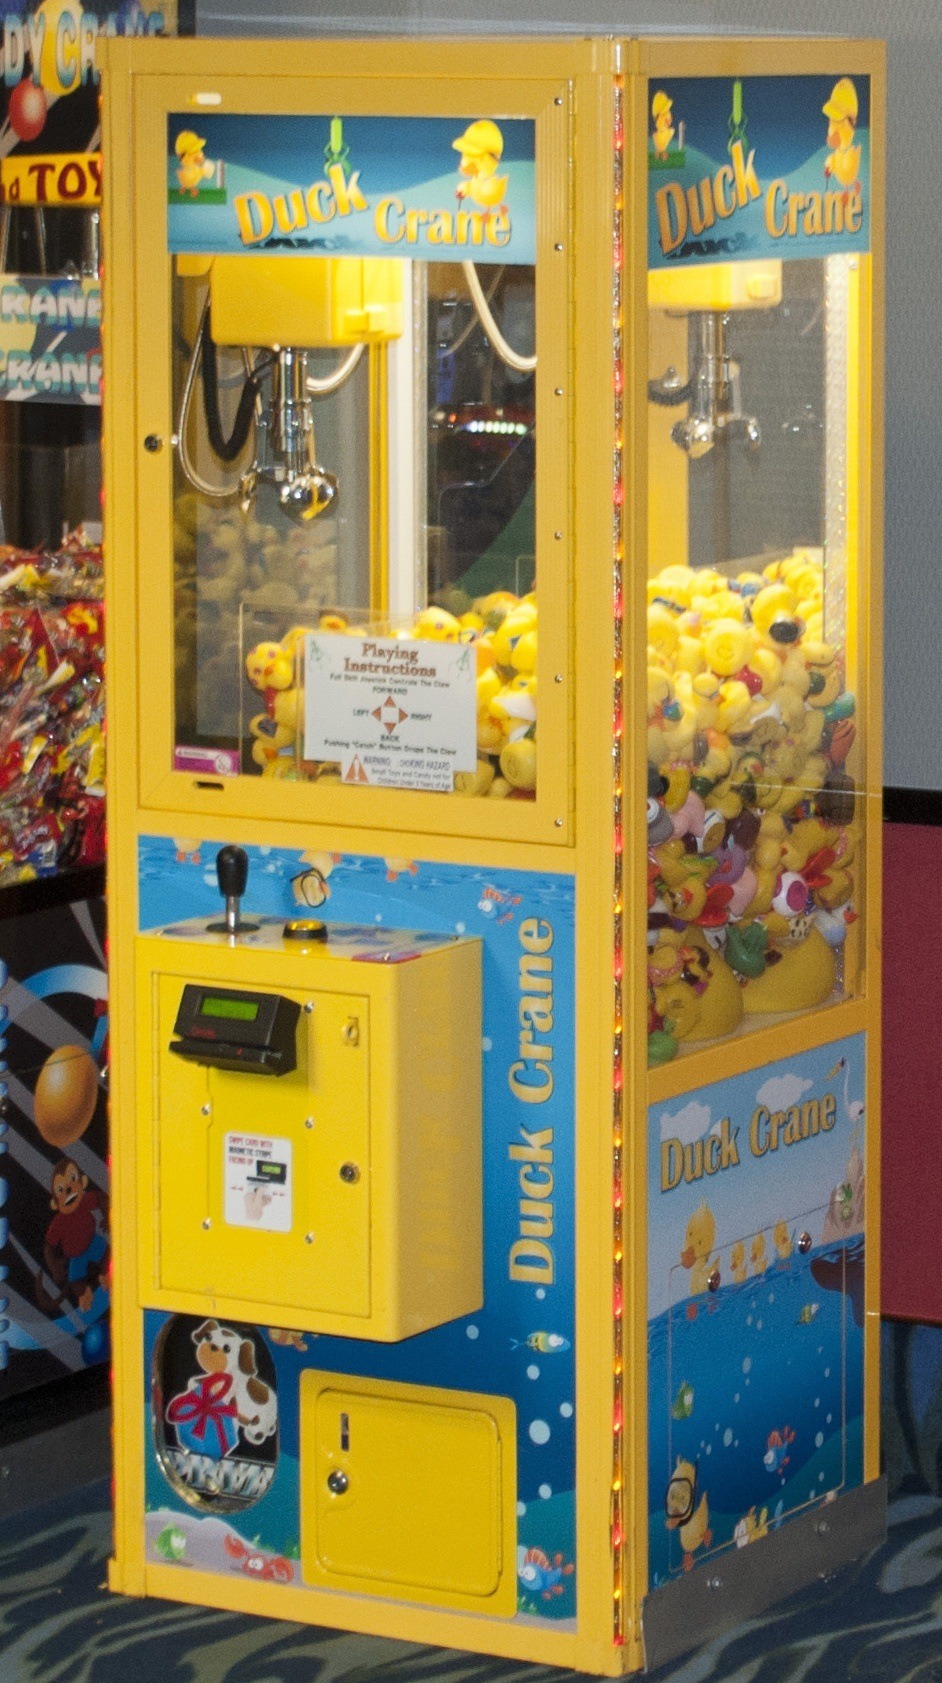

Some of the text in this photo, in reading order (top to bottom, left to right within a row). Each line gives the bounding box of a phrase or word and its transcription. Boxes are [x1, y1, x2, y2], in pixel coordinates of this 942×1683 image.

[0, 13, 47, 88] DY
[233, 163, 511, 246] Duck Crane
[655, 139, 863, 255] Duck Crane
[0, 348, 102, 394] RANE
[343, 657, 437, 677] Instructions
[361, 642, 419, 665] Playing
[353, 709, 370, 717] LEFT
[372, 686, 408, 695] FORWARD
[380, 734, 400, 742] BACK
[508, 916, 555, 1285] Duck Crane
[661, 1093, 837, 1194] Duck Crane
